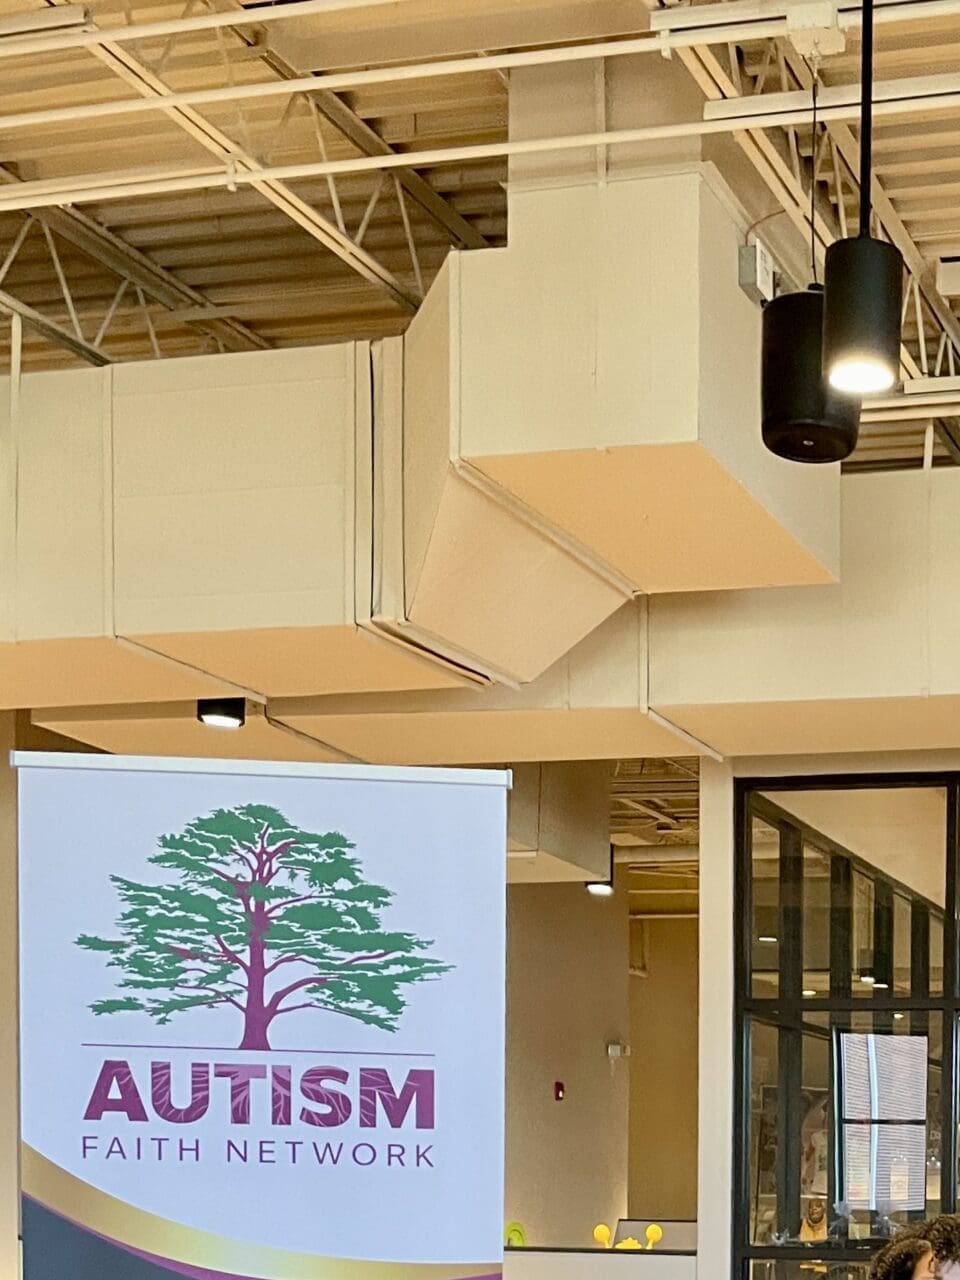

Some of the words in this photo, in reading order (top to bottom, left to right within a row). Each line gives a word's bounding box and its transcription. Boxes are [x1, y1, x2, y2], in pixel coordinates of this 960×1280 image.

[83, 1059, 435, 1130] AUTISM
[82, 1135, 200, 1162] FAITH
[227, 1138, 434, 1168] NETWORK
